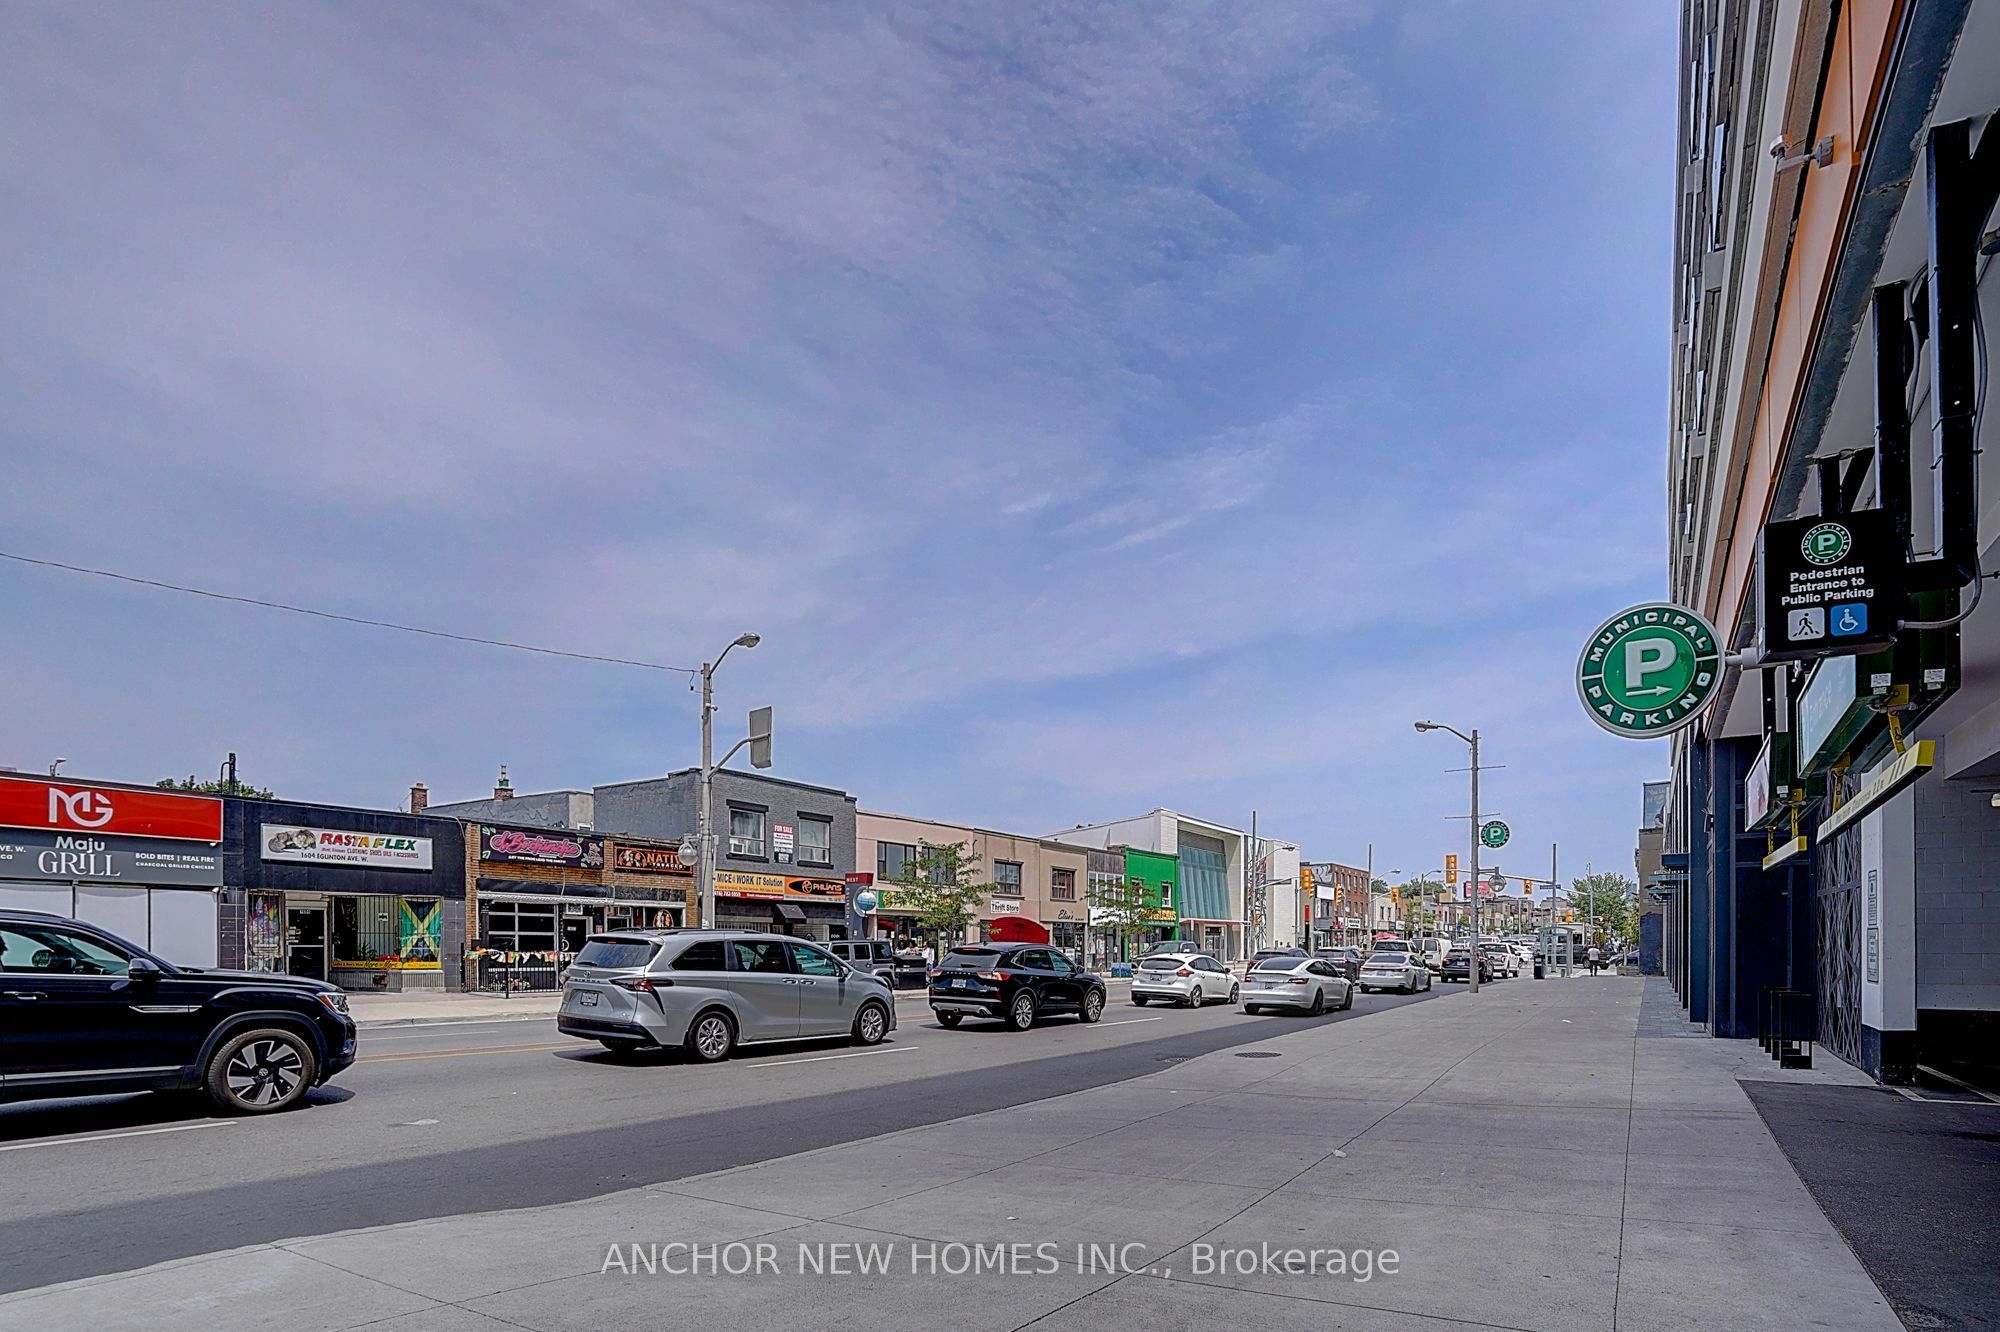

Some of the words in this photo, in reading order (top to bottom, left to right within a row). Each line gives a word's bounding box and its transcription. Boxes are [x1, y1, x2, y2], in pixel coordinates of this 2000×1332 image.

[1804, 525, 1847, 546] MUNICIPAL
[1817, 534, 1836, 551] P
[1804, 544, 1848, 563] PARKING
[1790, 566, 1865, 582] Pedestrian
[1790, 580, 1848, 593] Entrance
[1851, 577, 1865, 586] to
[1781, 594, 1821, 606] Public
[1824, 588, 1874, 601] Parking
[1590, 612, 1709, 662] MUNICIPAL
[1625, 637, 1677, 689] P
[1588, 672, 1711, 726] PARKING
[783, 826, 793, 834] SALE
[1490, 828, 1501, 839] P
[55, 836, 105, 854] Maju
[320, 833, 370, 848] RASTA
[373, 837, 416, 851] FLEX
[38, 850, 121, 877] GRILL
[717, 873, 732, 883] MICE
[736, 875, 754, 885] WORK
[756, 877, 762, 885] IT
[763, 877, 783, 887] Solution
[992, 903, 1006, 911] Thrift
